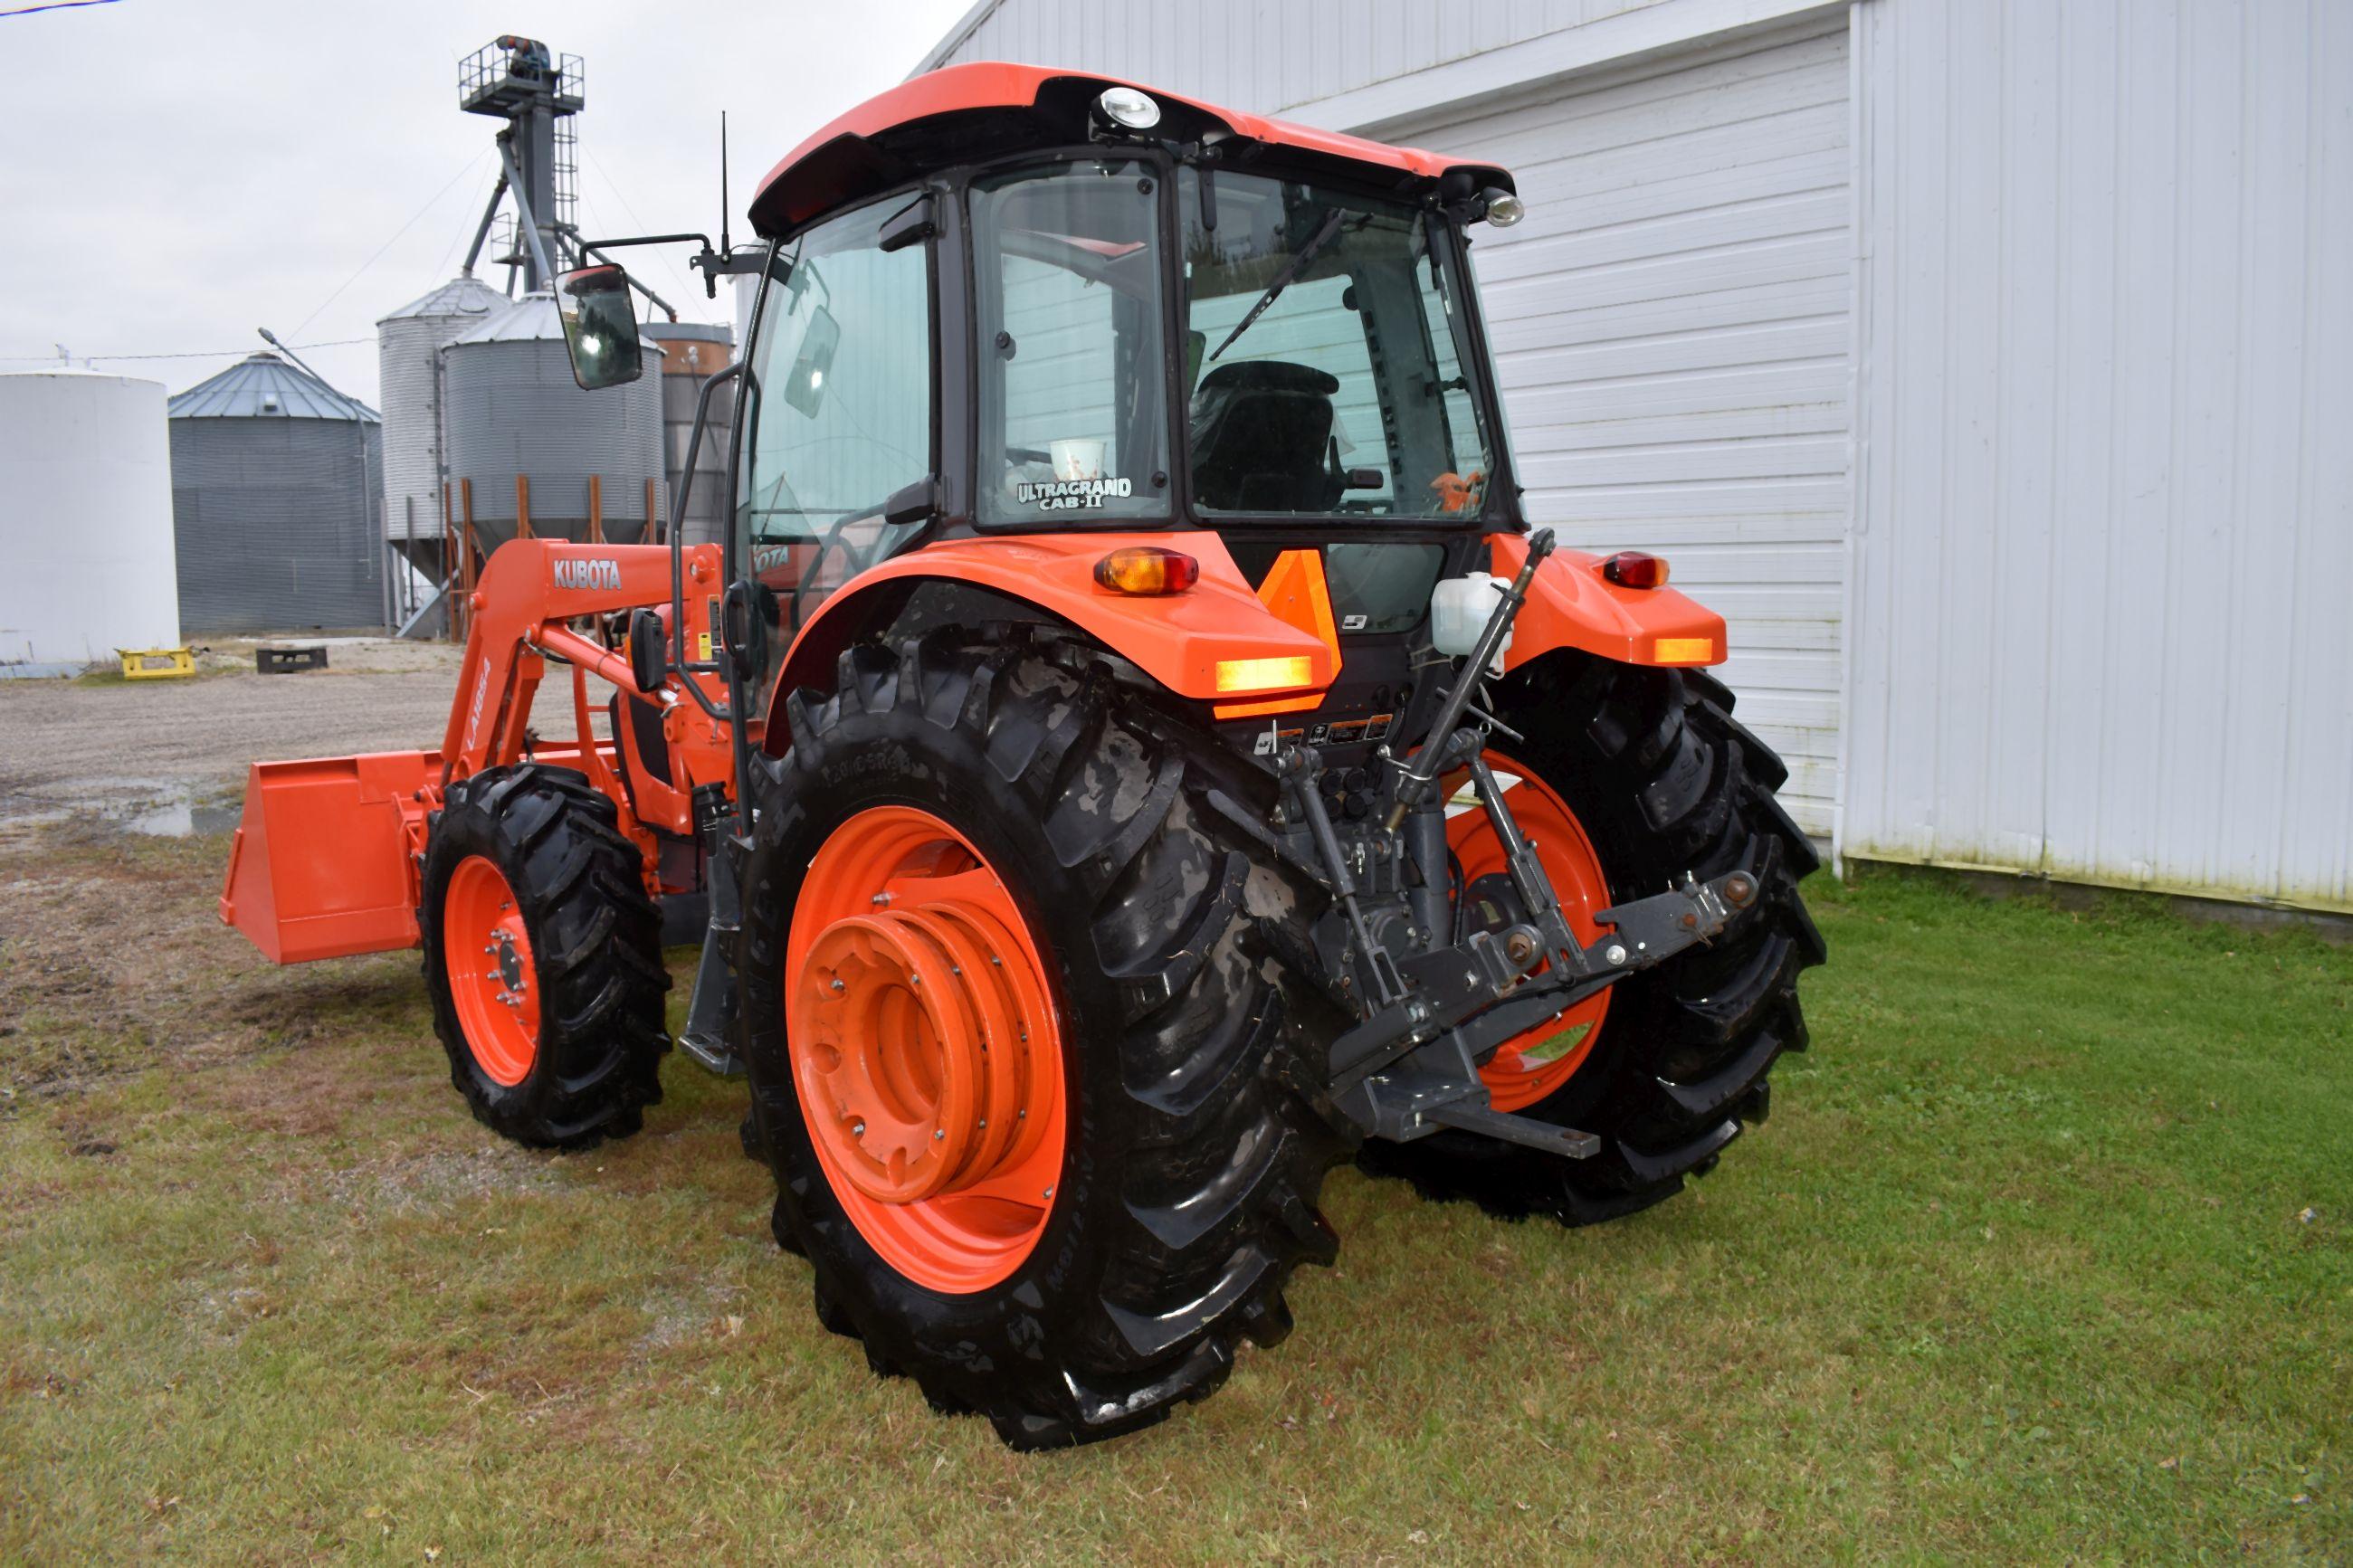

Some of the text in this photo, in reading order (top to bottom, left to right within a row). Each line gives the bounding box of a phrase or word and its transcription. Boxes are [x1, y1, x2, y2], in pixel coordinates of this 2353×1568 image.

[1018, 478, 1131, 503] ULTRAGRAND
[1040, 495, 1102, 510] CAB-II
[553, 559, 622, 590] KUBOTA
